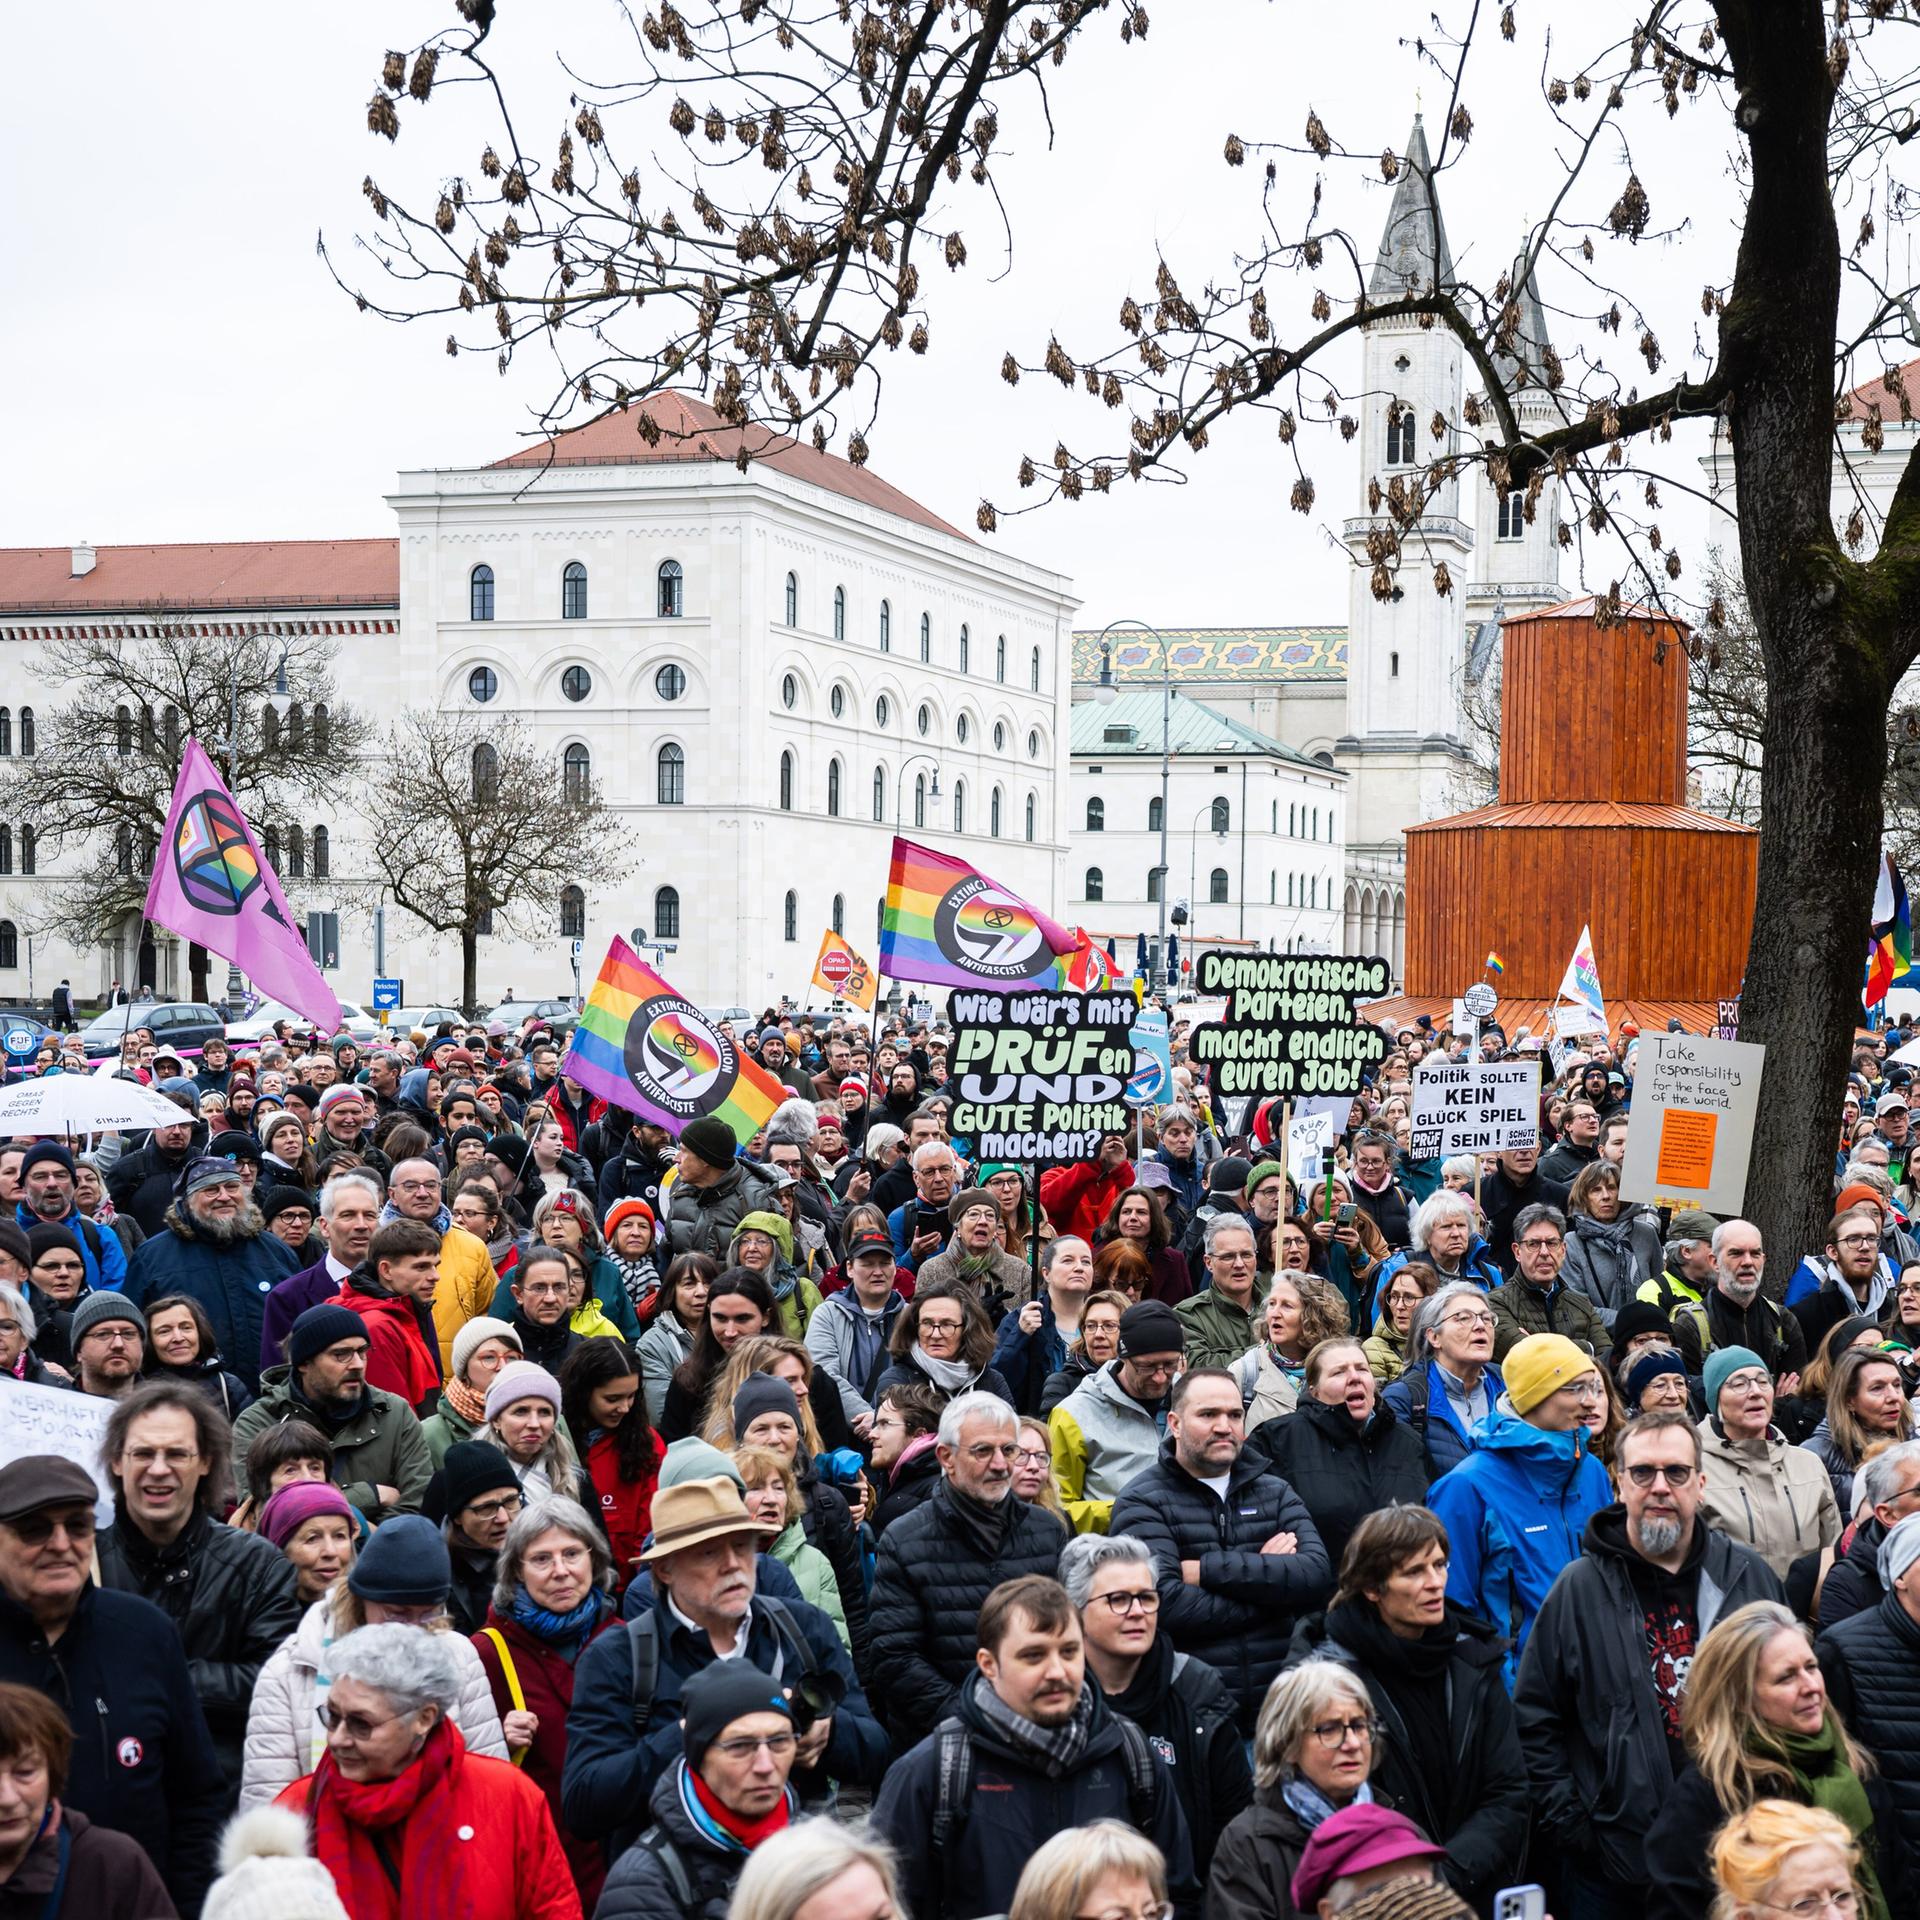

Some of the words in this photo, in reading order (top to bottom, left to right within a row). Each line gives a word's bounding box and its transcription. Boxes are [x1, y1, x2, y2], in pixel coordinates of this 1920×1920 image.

[957, 955, 1028, 975] ANTIFASCISTE
[1204, 955, 1385, 992] Demokratische
[954, 994, 1003, 1023] Wie
[1010, 996, 1080, 1025] wär's
[1088, 997, 1134, 1025] mit
[1234, 988, 1351, 1024] Parteien,
[647, 1000, 705, 1022] EXTINCTION
[706, 1021, 734, 1074] REBELLION
[1198, 1028, 1283, 1059] macht
[1288, 1027, 1384, 1060] endlich
[953, 1025, 1131, 1075] PRÜFen
[1653, 1036, 1696, 1062] Take
[1220, 1060, 1294, 1092] euren
[1300, 1060, 1362, 1092] Job!
[1419, 1069, 1470, 1085] Politik
[1480, 1072, 1528, 1084] SOLLTE
[1655, 1063, 1742, 1087] responsibility
[17, 1090, 45, 1098] OMAS
[635, 1070, 695, 1113] ANTIFASCISTE
[960, 1074, 1122, 1104] UND
[1445, 1087, 1495, 1106] KEIN
[1653, 1078, 1672, 1091] for
[1675, 1081, 1693, 1093] the
[1698, 1082, 1728, 1097] face
[8, 1098, 43, 1107] GEGEN
[1651, 1092, 1666, 1102] of
[1671, 1093, 1690, 1105] the
[1694, 1097, 1732, 1110] world.
[1, 1107, 40, 1117] RECHTS
[953, 1103, 1036, 1132] GUTE
[1043, 1102, 1127, 1132] Politik
[1416, 1110, 1467, 1126] GLÜCK
[1479, 1108, 1527, 1123] SPIEL
[1292, 1119, 1328, 1141] PRÜF!
[1413, 1131, 1441, 1147] PRÜF
[1451, 1132, 1490, 1147] SEIN
[1495, 1129, 1501, 1145] !
[1509, 1129, 1536, 1139] SCHÜTZ
[980, 1129, 1102, 1158] machen?
[1412, 1146, 1439, 1159] HEUTE
[1508, 1138, 1534, 1148] MORGEN
